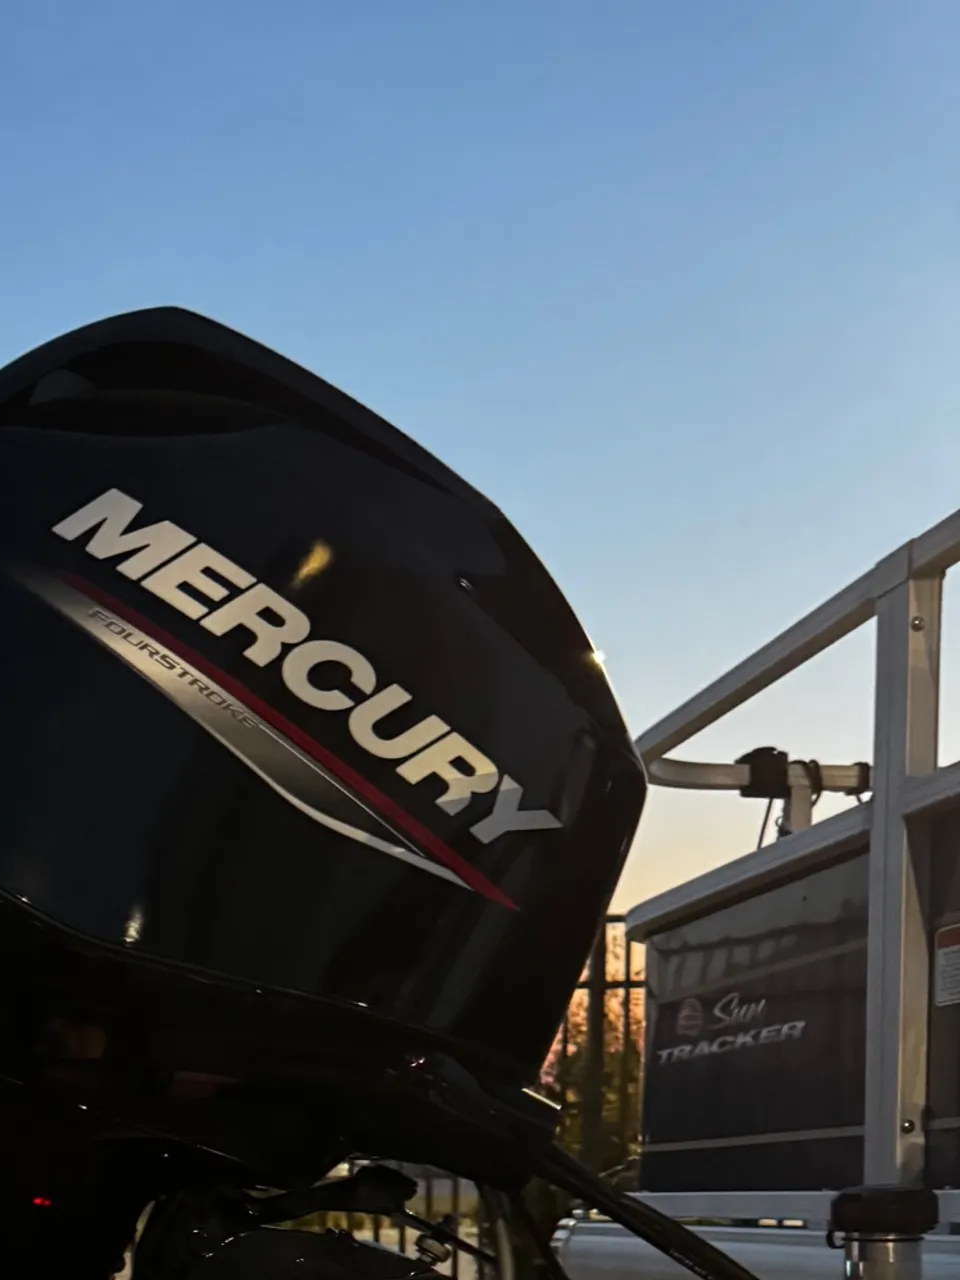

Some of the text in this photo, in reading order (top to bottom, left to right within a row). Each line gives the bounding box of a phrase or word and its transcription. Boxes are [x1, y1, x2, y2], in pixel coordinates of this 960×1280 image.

[52, 488, 563, 844] MERCURY
[707, 992, 767, 1030] Sun
[656, 1020, 807, 1065] TRACKER
